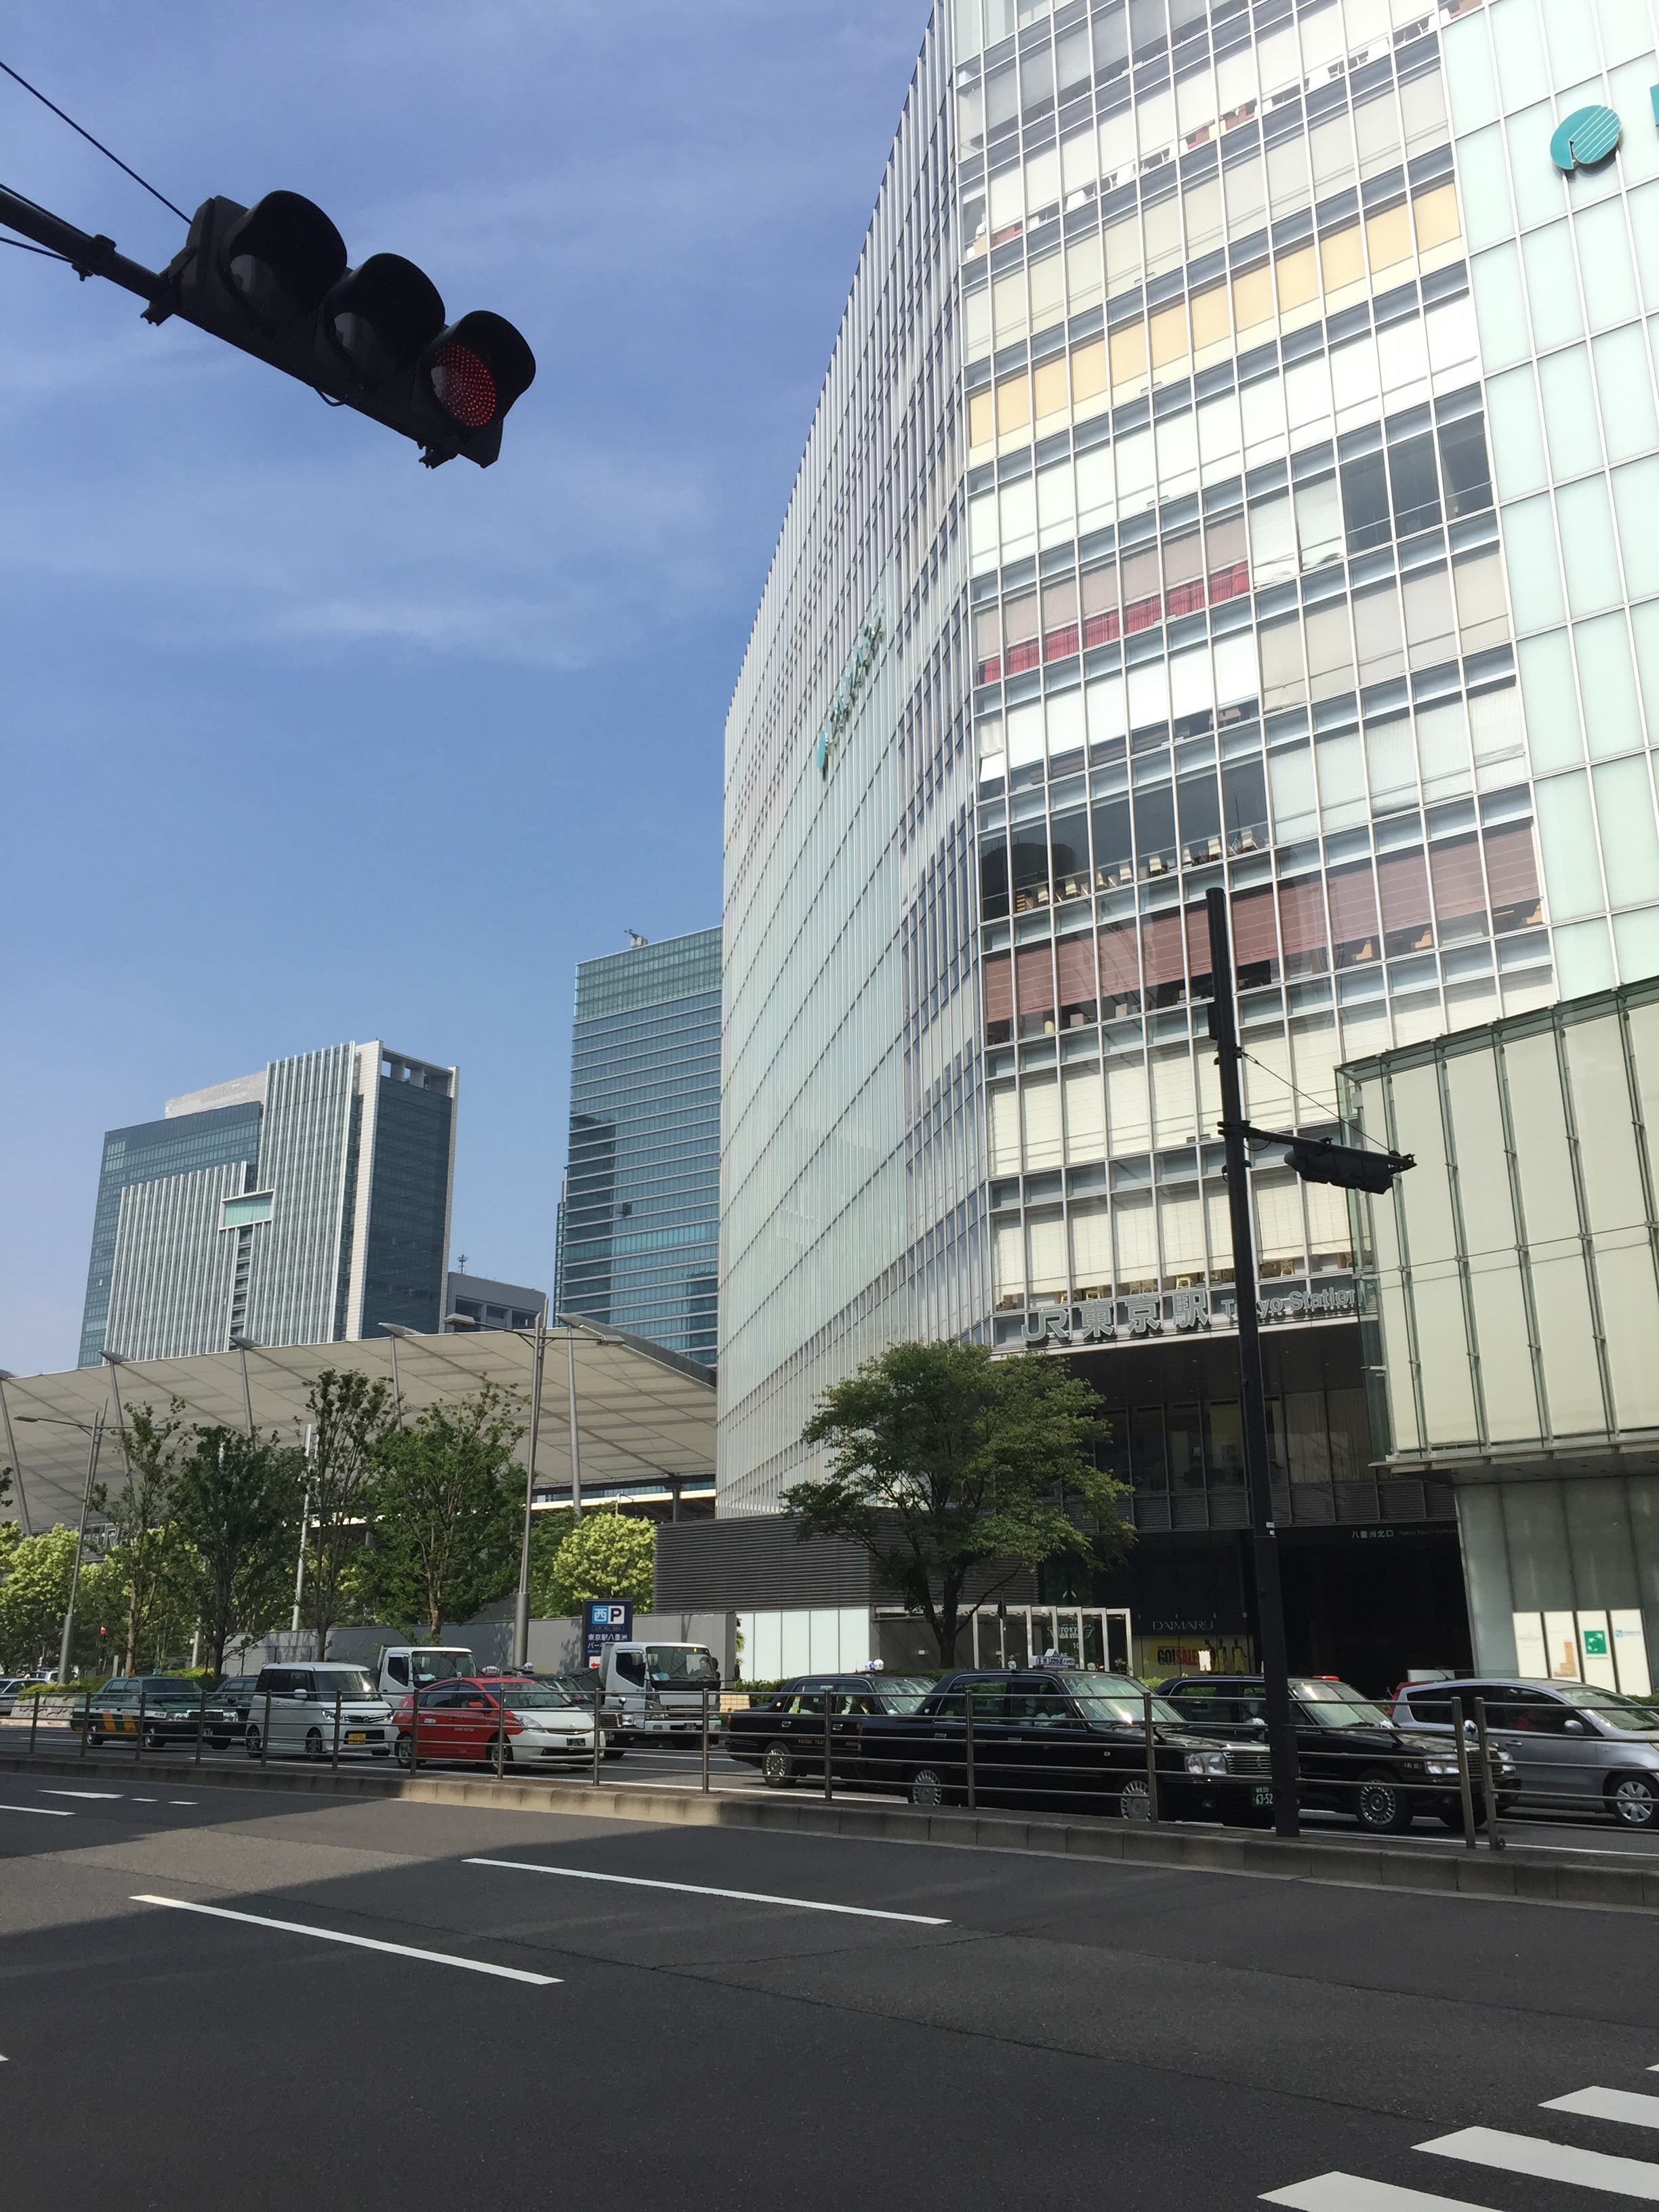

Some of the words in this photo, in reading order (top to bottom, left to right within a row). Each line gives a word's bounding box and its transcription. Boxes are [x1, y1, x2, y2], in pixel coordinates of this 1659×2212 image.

[1221, 1297, 1284, 1319] Tyo
[1021, 1290, 1210, 1341] JR東京駅
[1352, 1529, 1394, 1538] 八重洲北口
[594, 1608, 607, 1622] 西
[611, 1608, 621, 1622] P
[1152, 1620, 1213, 1630] DAIMARU
[1256, 1793, 1273, 1805] 63-52
